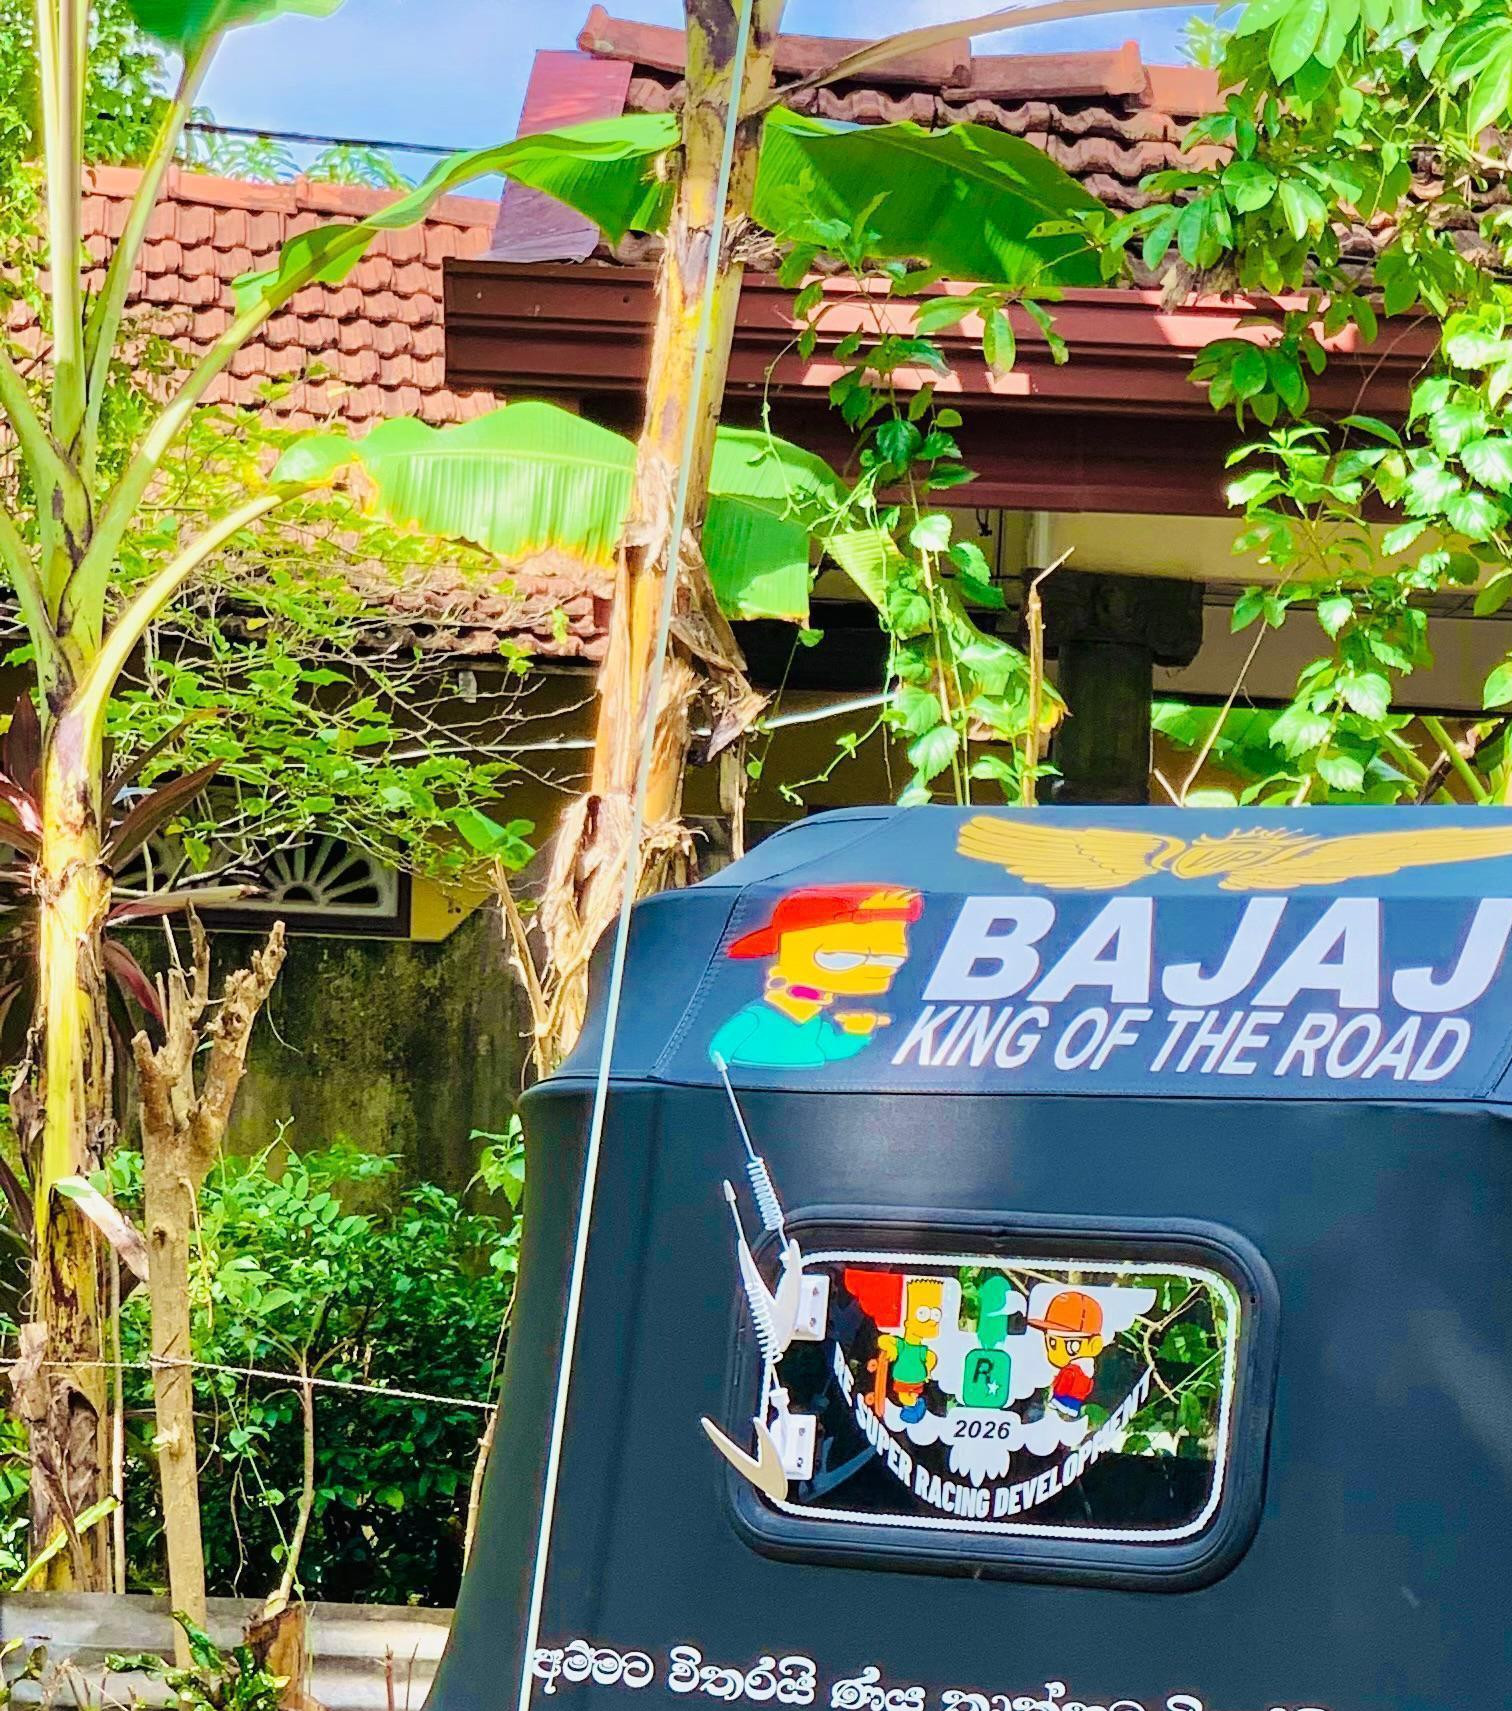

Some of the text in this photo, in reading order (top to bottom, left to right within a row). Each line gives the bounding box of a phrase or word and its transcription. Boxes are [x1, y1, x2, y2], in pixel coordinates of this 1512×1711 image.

[891, 1004, 1472, 1082] KING OF THE ROAD
[855, 1392, 913, 1487] SUPER
[914, 1463, 991, 1519] RACING
[953, 1419, 1011, 1440] 2026
[668, 1645, 817, 1705] විතරයි
